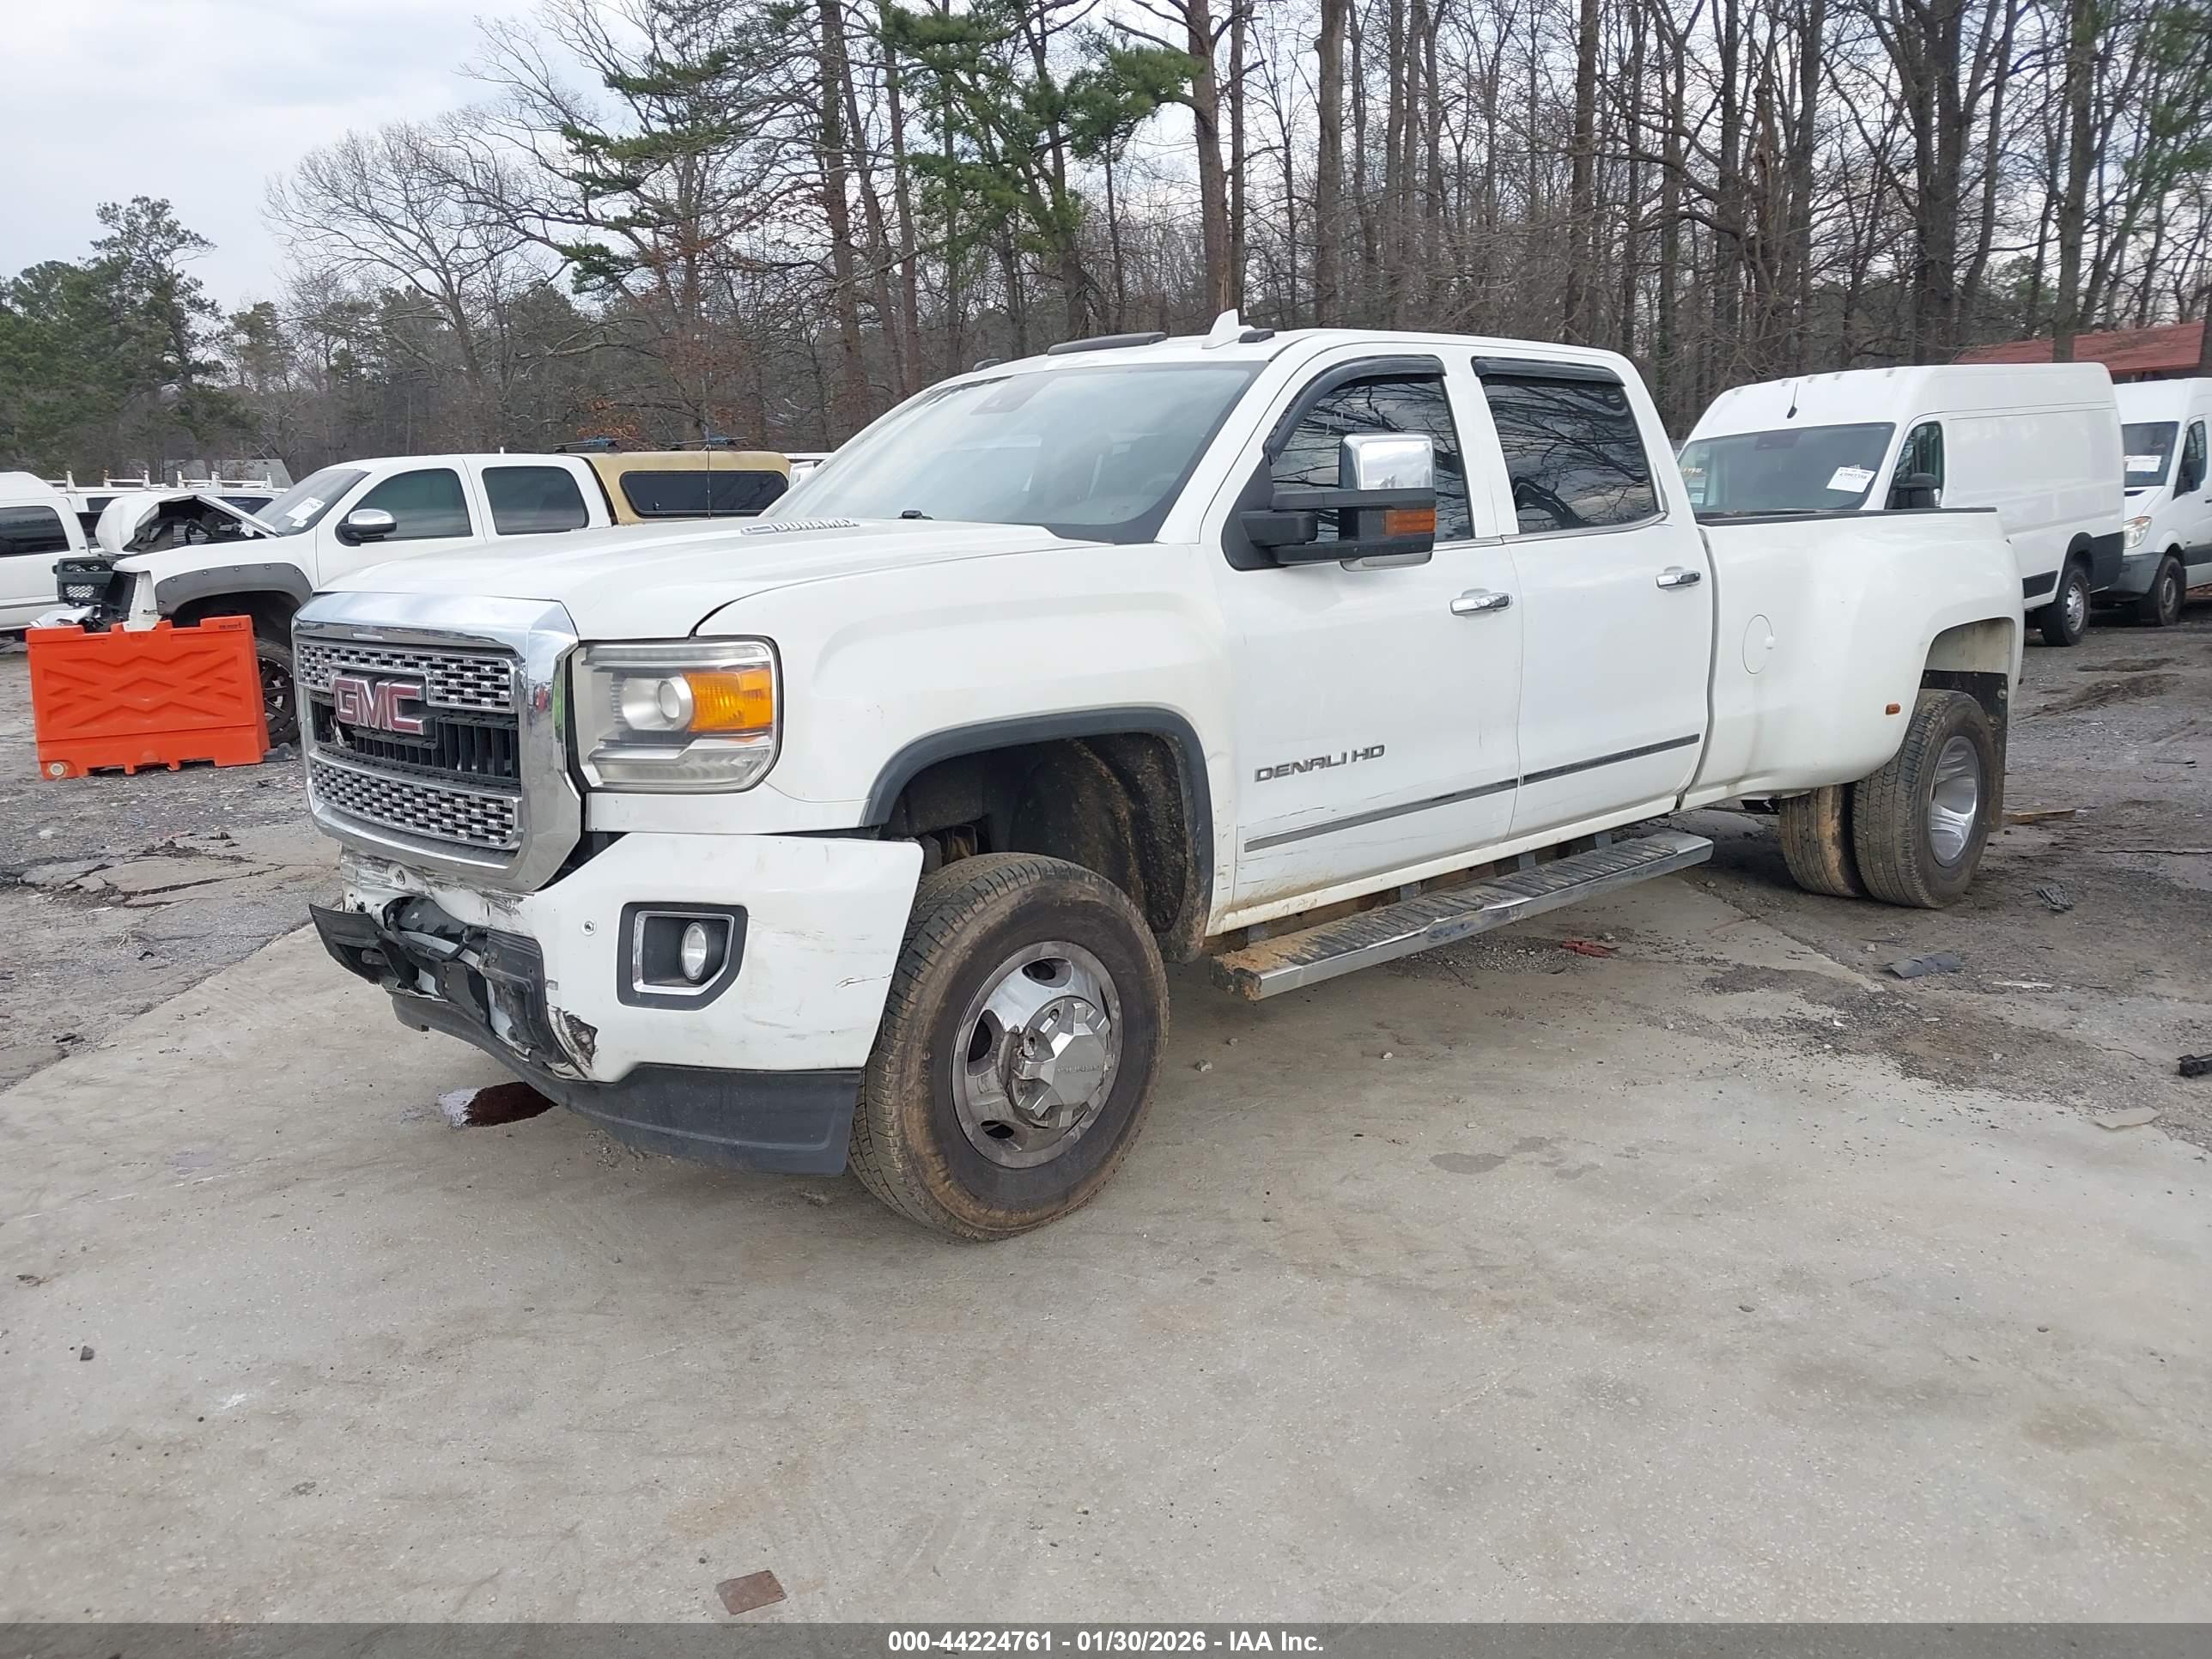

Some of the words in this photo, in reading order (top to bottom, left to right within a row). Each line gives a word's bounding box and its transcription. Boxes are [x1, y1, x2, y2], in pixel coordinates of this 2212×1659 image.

[772, 518, 860, 532] DURAMAX
[333, 677, 423, 735] GMC
[1255, 751, 1347, 782] DENALI
[1351, 744, 1385, 763] HD
